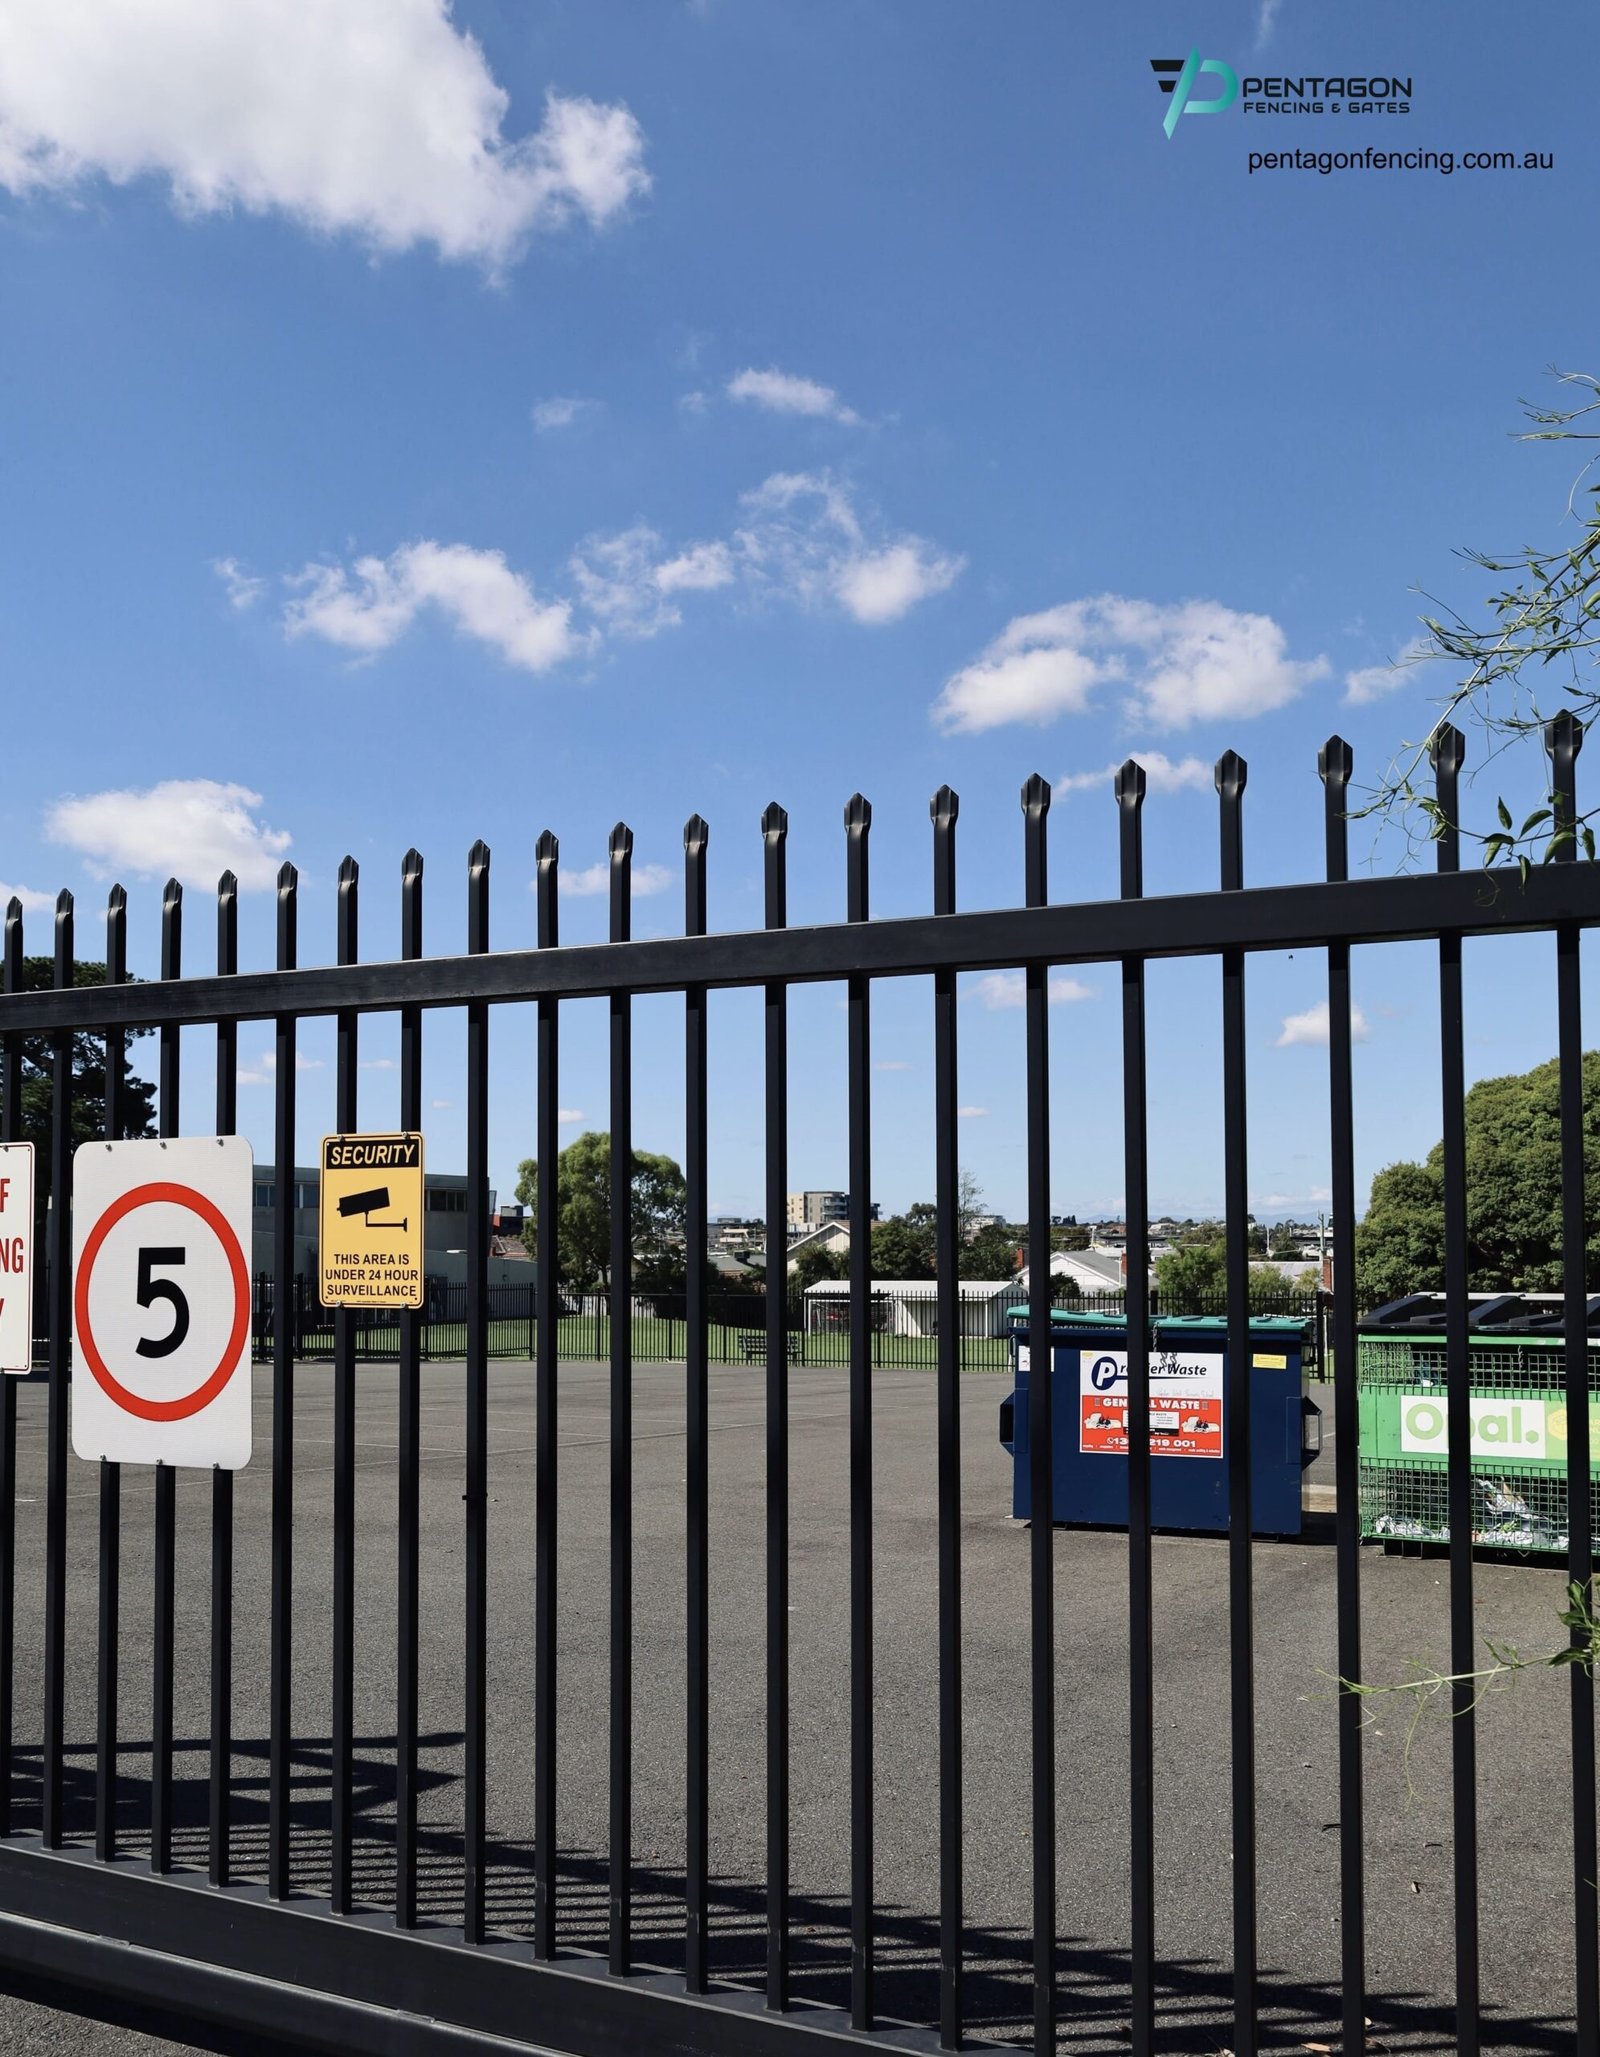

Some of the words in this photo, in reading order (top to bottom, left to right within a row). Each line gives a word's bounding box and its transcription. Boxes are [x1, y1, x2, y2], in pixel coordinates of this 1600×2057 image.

[330, 1144, 415, 1166] SECURITY
[334, 1253, 360, 1265] THIS
[363, 1253, 395, 1265] AREA
[398, 1253, 410, 1265] IS
[325, 1269, 365, 1281] UNDER
[368, 1269, 381, 1281] 24
[385, 1269, 419, 1281] HOUR
[327, 1284, 417, 1297] SURVEILLANCE
[136, 1246, 190, 1359] 5
[1096, 1361, 1164, 1386] Prer
[1167, 1363, 1207, 1376] Waste
[1103, 1398, 1157, 1409] GENL
[1159, 1400, 1200, 1410] WASTE
[1405, 1402, 1539, 1444] Oal.
